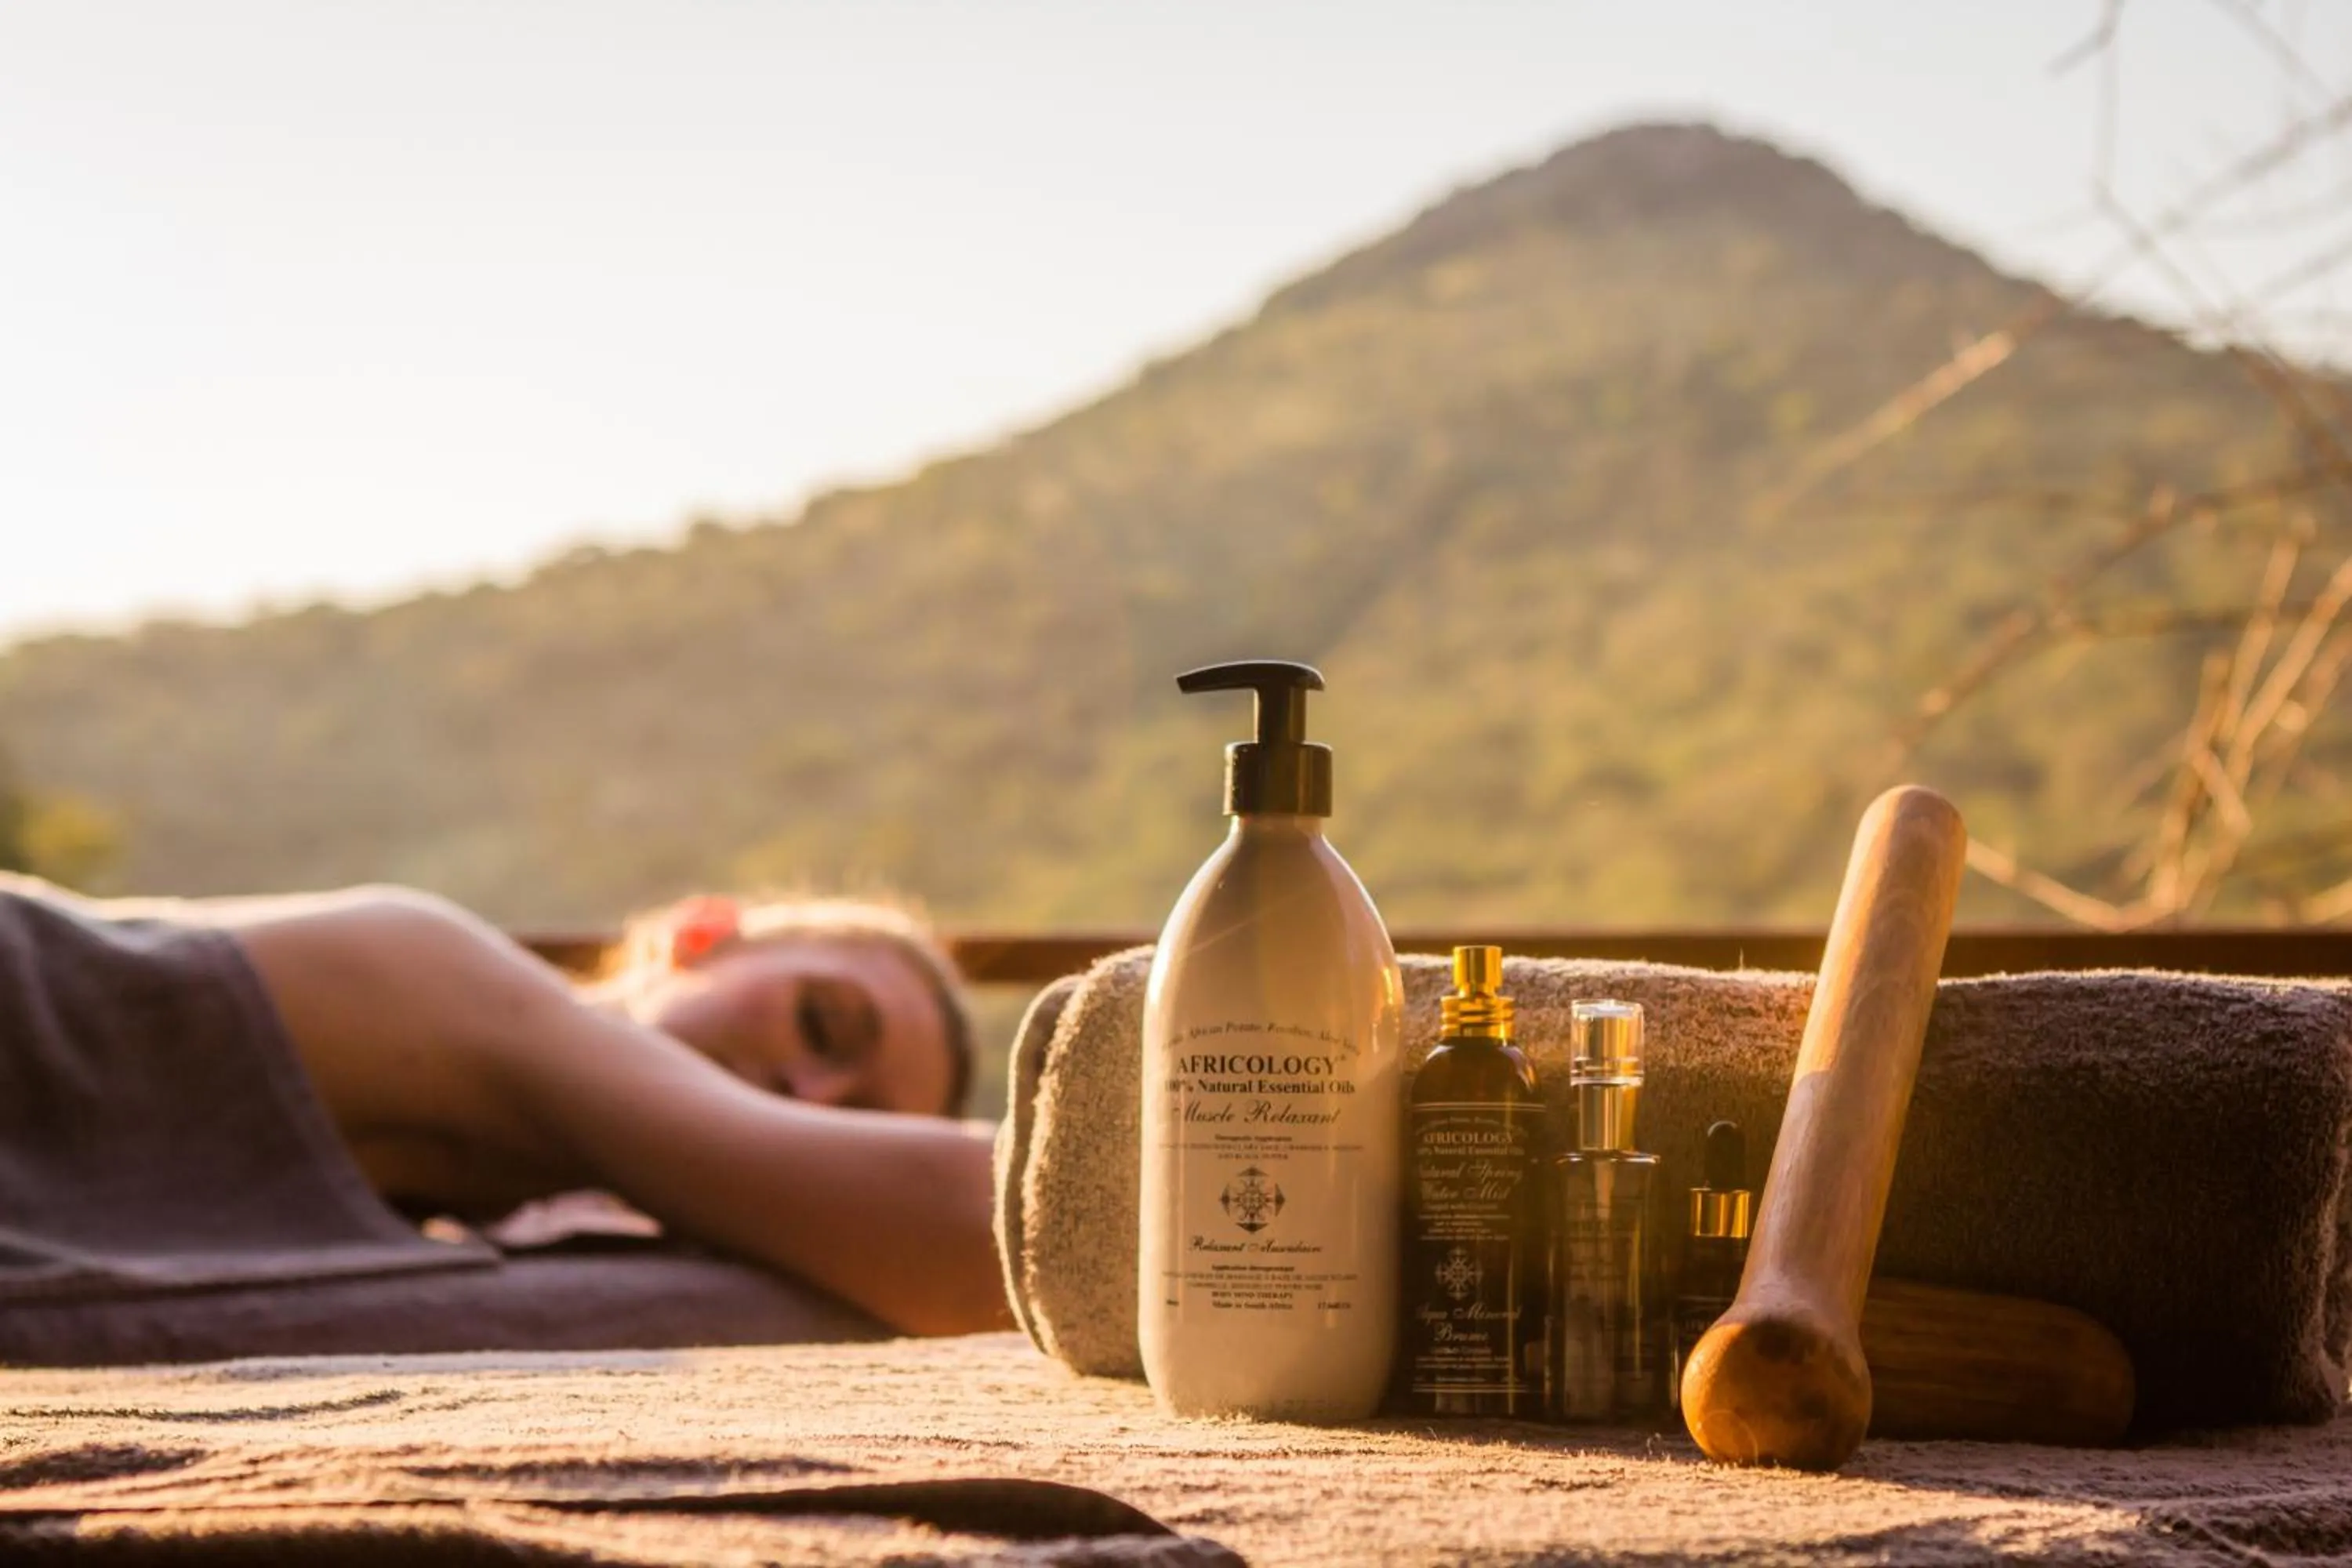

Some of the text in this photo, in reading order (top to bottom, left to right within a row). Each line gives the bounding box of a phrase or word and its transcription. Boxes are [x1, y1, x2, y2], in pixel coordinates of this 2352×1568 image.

[1177, 1054, 1333, 1075] AFRICOLOGY
[1197, 1079, 1253, 1094] Natural
[1258, 1079, 1324, 1094] Essential
[1329, 1079, 1356, 1094] Oils
[1173, 1098, 1341, 1124] Muscle Relaxant
